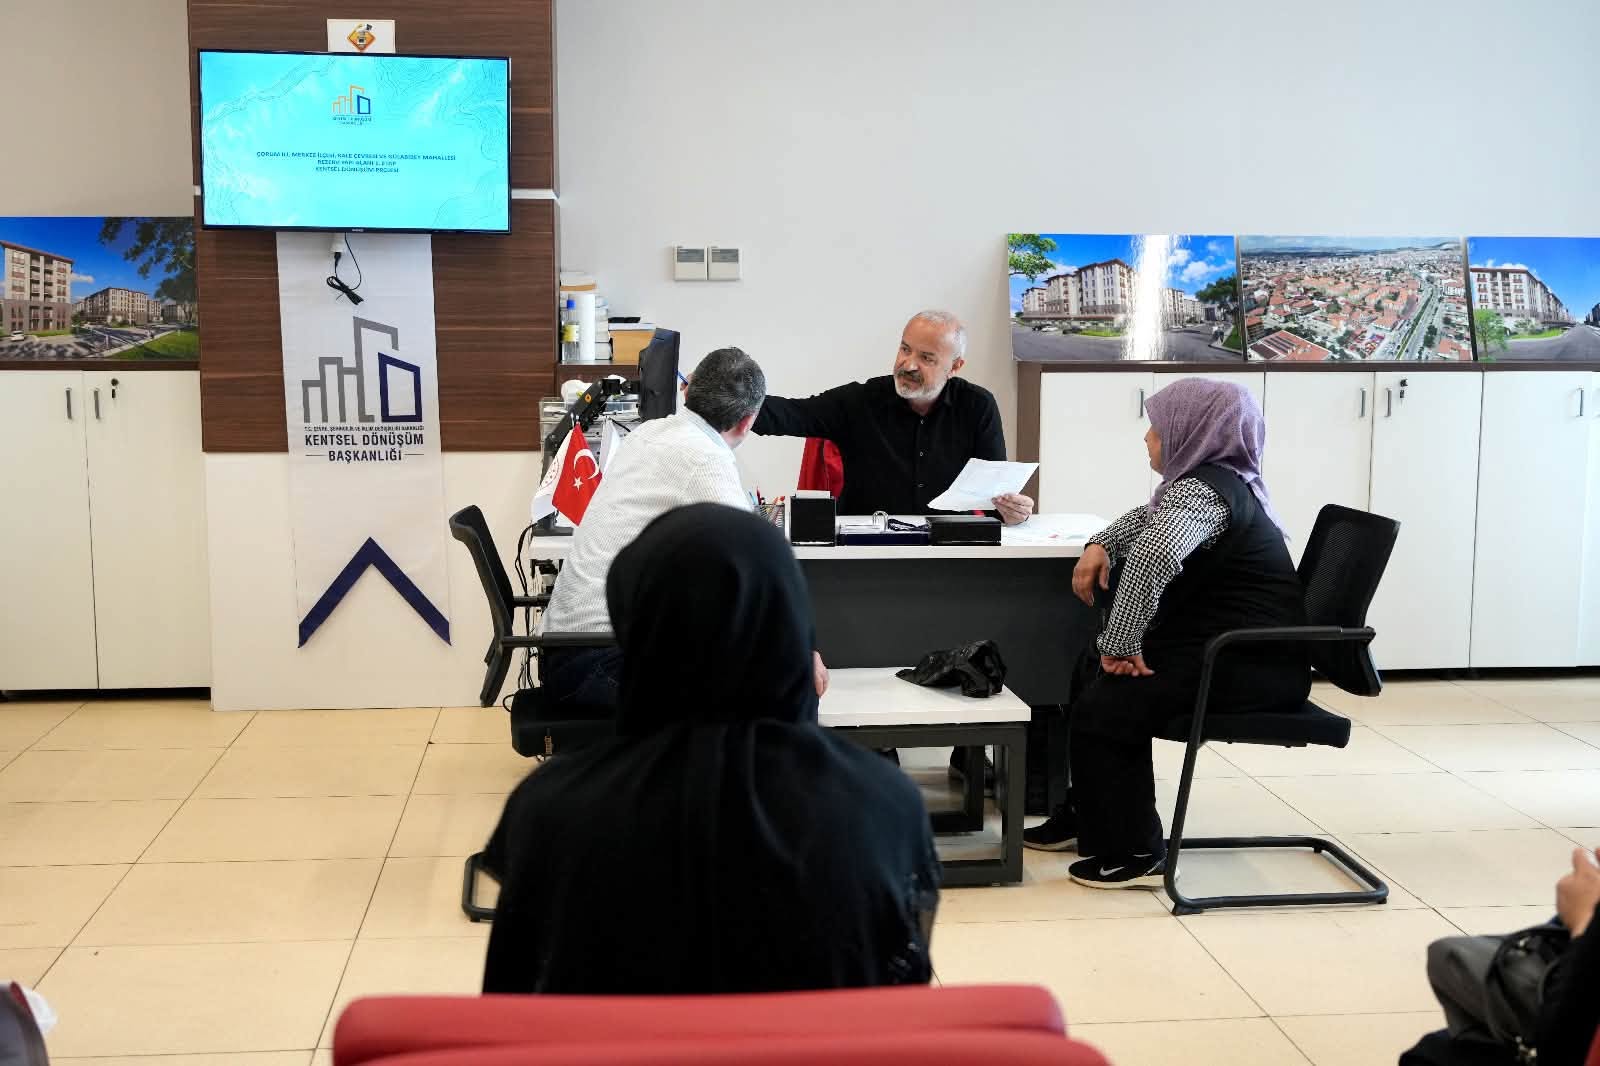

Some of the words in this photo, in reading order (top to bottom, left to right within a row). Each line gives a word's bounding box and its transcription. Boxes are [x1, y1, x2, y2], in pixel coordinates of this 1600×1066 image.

[305, 434, 358, 446] KENTSEL
[362, 432, 424, 448] DÖNÜŞÜM
[328, 448, 402, 464] BAŞKANLIĞI
